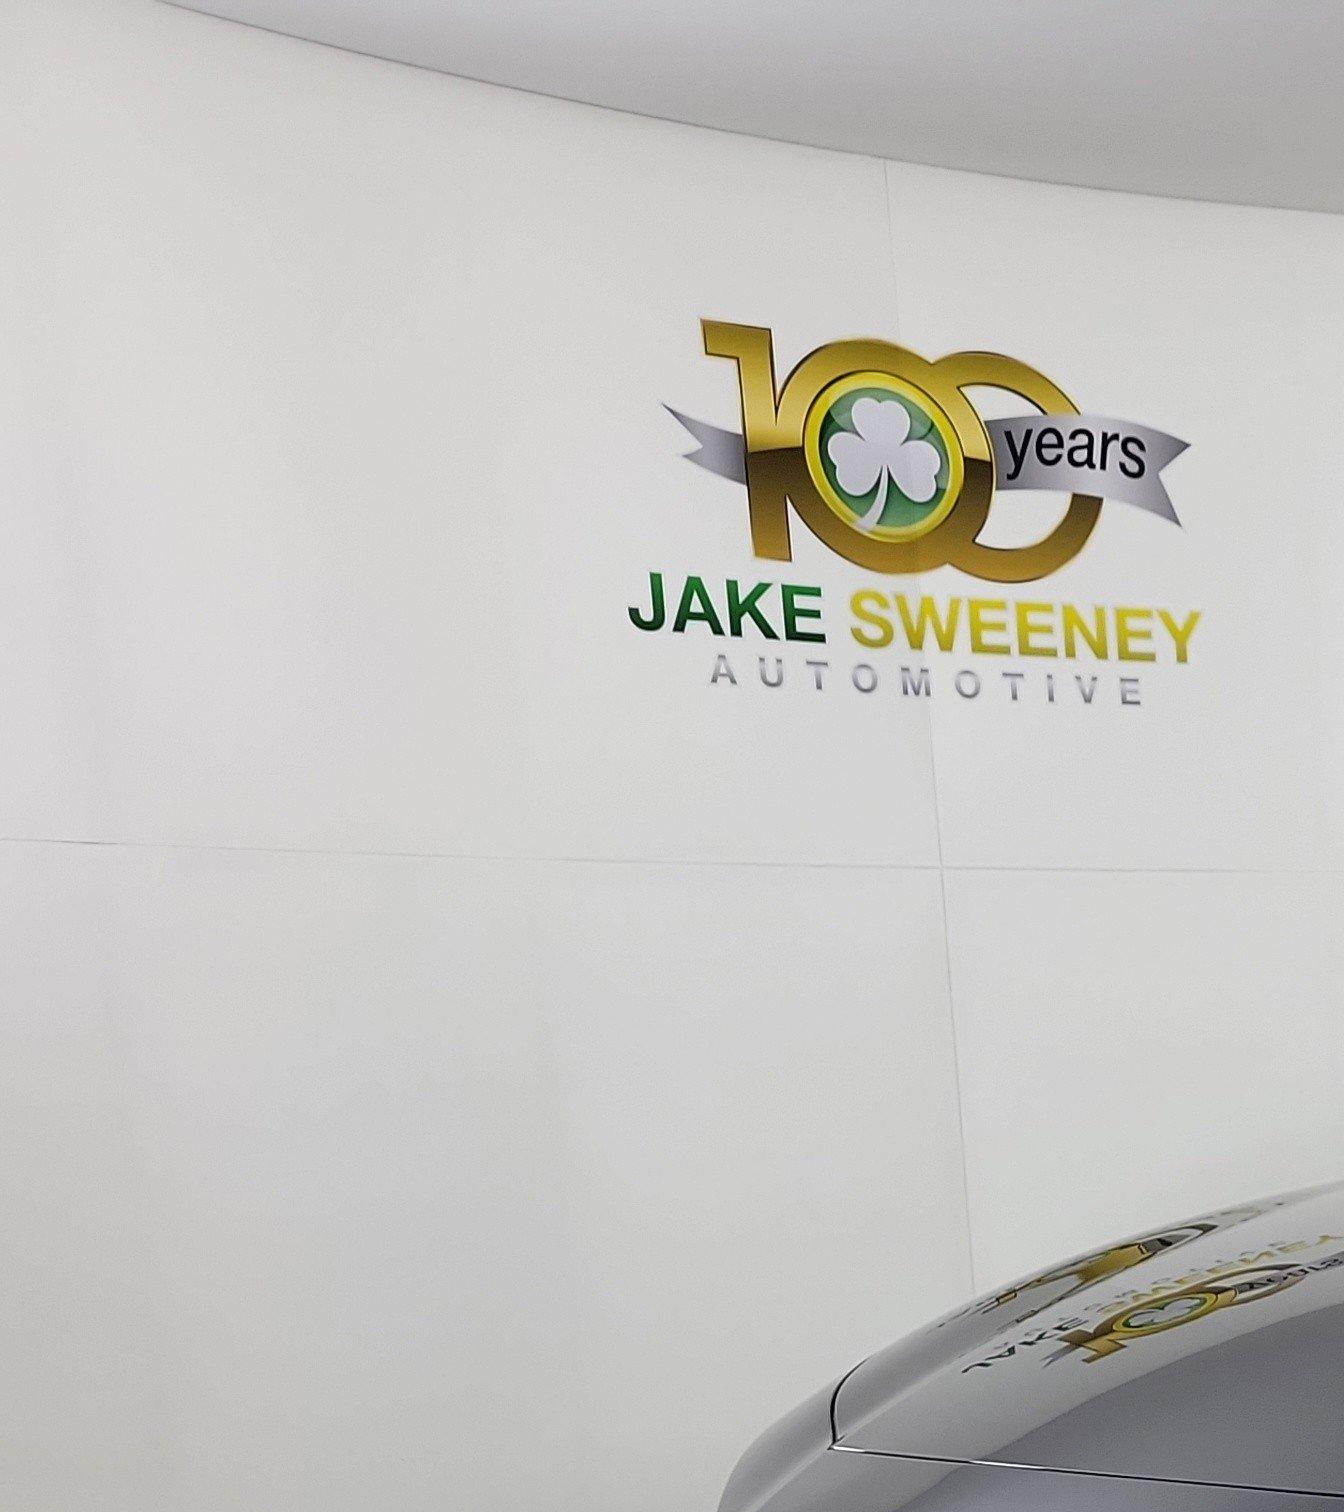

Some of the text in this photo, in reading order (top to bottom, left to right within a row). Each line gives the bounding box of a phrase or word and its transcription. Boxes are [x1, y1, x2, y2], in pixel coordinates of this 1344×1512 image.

[700, 318, 1104, 583] 100
[1003, 427, 1147, 480] years
[628, 572, 1202, 664] JAKE SWEENEY
[710, 655, 1142, 706] AUTOMOTIVE
